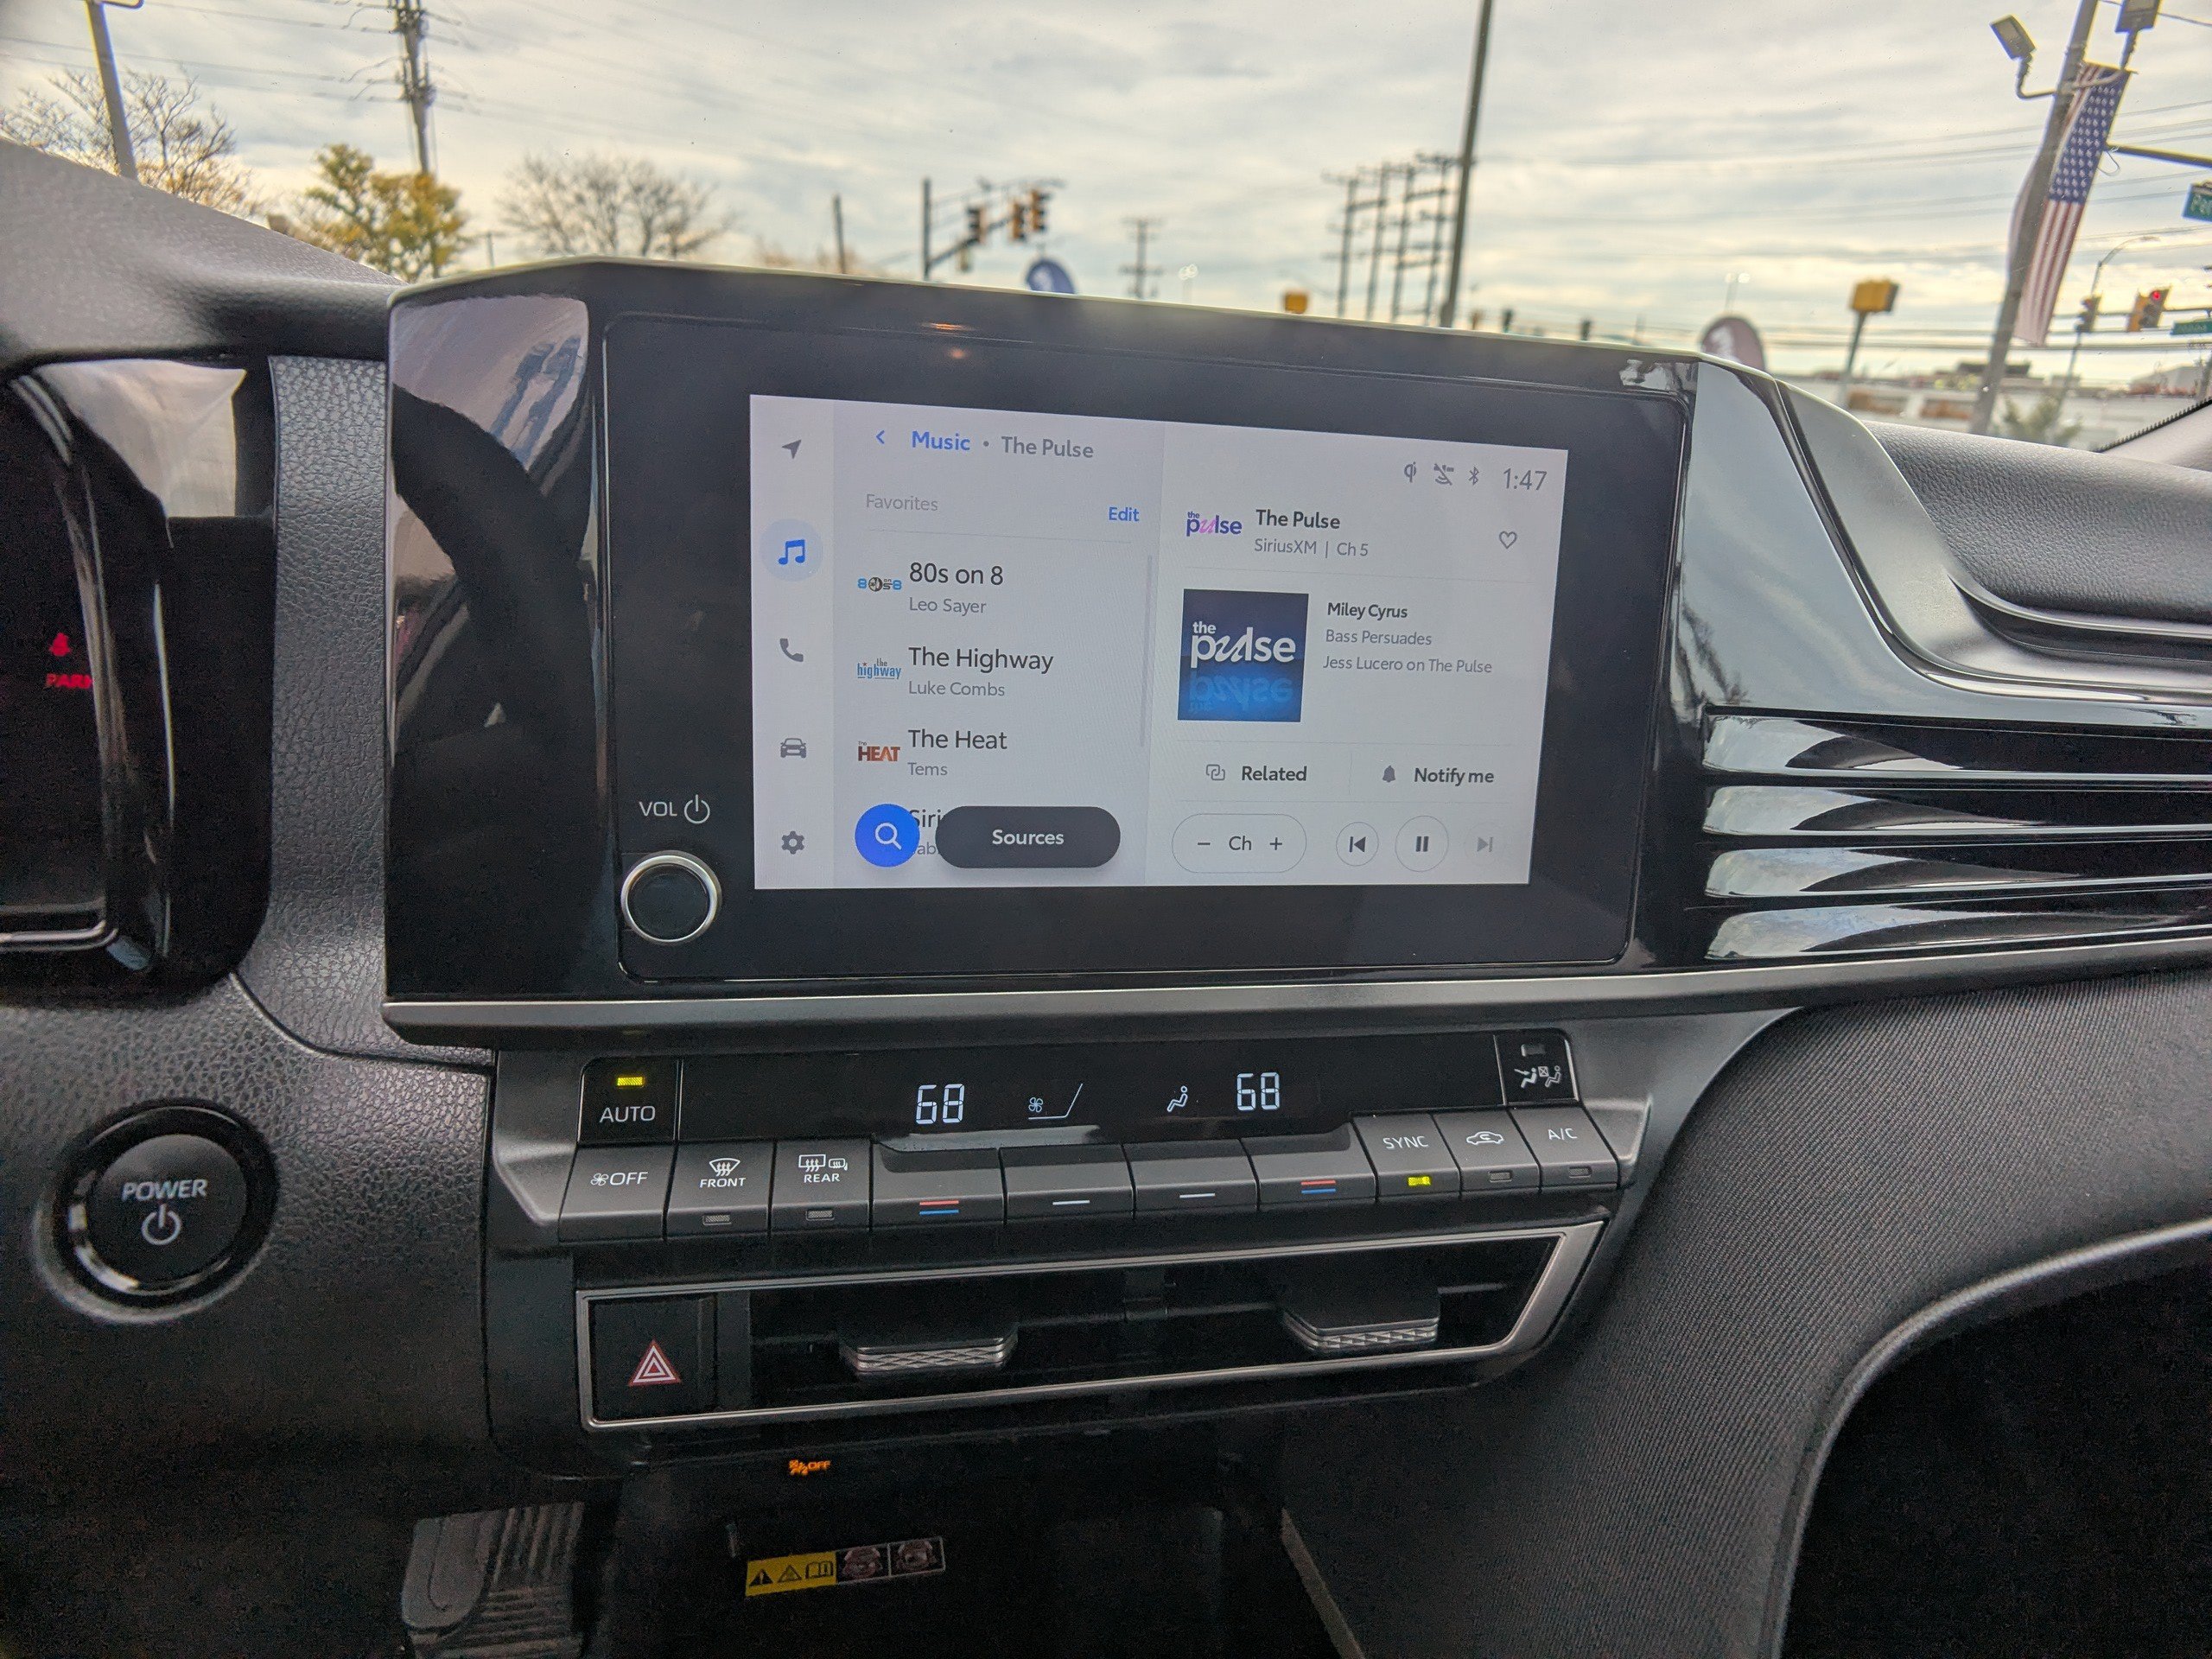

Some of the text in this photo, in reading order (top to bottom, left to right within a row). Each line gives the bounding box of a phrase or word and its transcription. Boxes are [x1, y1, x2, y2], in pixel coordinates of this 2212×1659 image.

[912, 430, 1094, 458] Music The Pulse
[1503, 467, 1548, 491] 1:47
[866, 493, 938, 512] Favorites
[1109, 506, 1140, 522] Edit
[1187, 511, 1200, 519] the
[1255, 509, 1341, 530] The Pulse
[1186, 515, 1243, 537] pulse
[1255, 537, 1317, 556] SiriusXM
[1337, 542, 1356, 557] Ch
[1360, 543, 1369, 557] 5
[909, 562, 1004, 586] 80s on 8
[909, 597, 987, 616] Leo Sayer
[1327, 602, 1408, 620] Miley Cyrus
[1192, 621, 1217, 634] the
[1325, 630, 1433, 646] Bass Persuades
[1190, 626, 1296, 669] pulse
[876, 658, 887, 666] the
[908, 646, 1054, 674] The Highway
[1323, 657, 1492, 674] Jess Lucero on The Pulse
[857, 663, 901, 679] highway
[909, 680, 1005, 697] Luke Combs
[908, 729, 1007, 750] The Heat
[858, 746, 900, 762] HEAT
[908, 762, 948, 776] Tems
[1241, 766, 1307, 782] Related
[1414, 767, 1494, 787] Notify me
[639, 801, 677, 817] VOL
[992, 829, 1065, 846] Sources
[1229, 836, 1252, 851] Ch
[1236, 1071, 1281, 1111] 68
[915, 1083, 965, 1125] 68
[599, 1105, 656, 1123] AUTO
[1382, 1135, 1429, 1150] SYNC
[1548, 1128, 1578, 1141] A/C
[609, 1172, 648, 1186] OFF
[699, 1177, 747, 1189] FRONT
[804, 1173, 841, 1184] REAR
[121, 1178, 208, 1203] POWER
